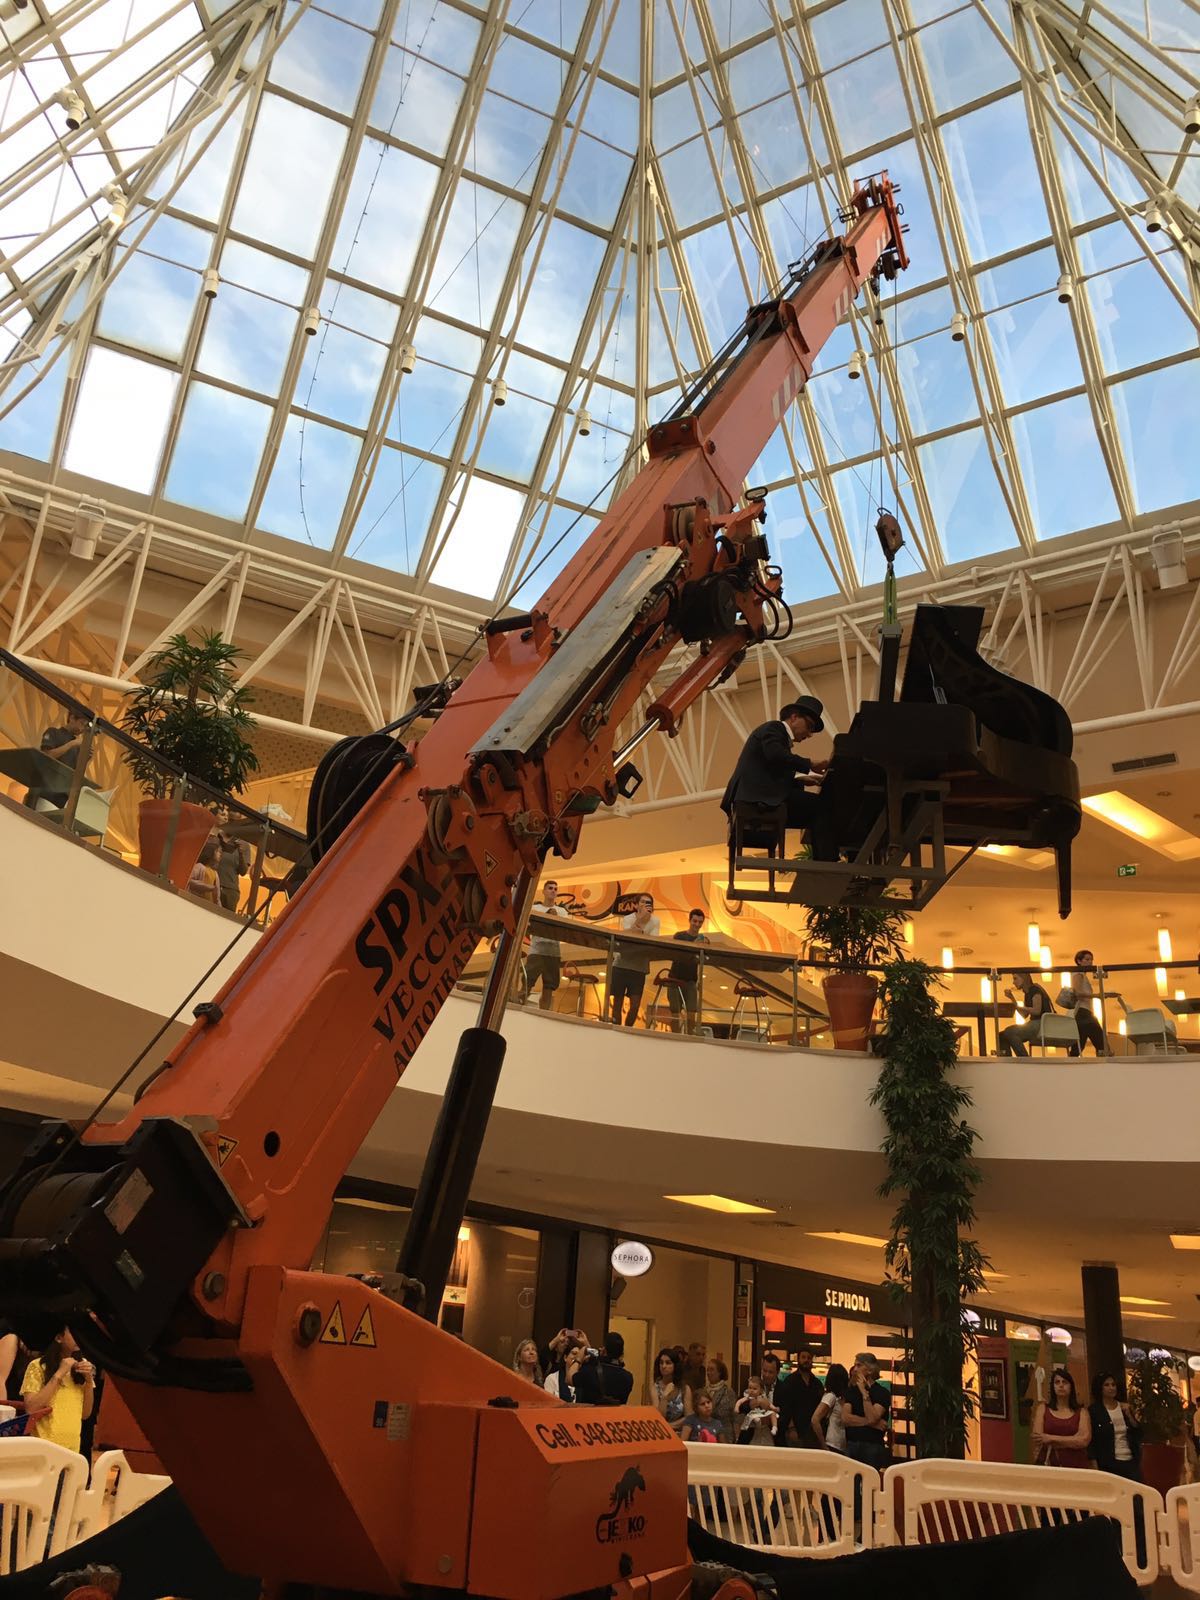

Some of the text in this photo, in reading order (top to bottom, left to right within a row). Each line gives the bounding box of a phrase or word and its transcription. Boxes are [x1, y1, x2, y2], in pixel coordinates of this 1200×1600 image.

[354, 848, 447, 997] SPX
[372, 901, 463, 1043] VECCH
[613, 1253, 649, 1263] SEPHORA
[825, 1288, 871, 1312] SEPHORA
[535, 1418, 672, 1449] Cell. 348.8588080
